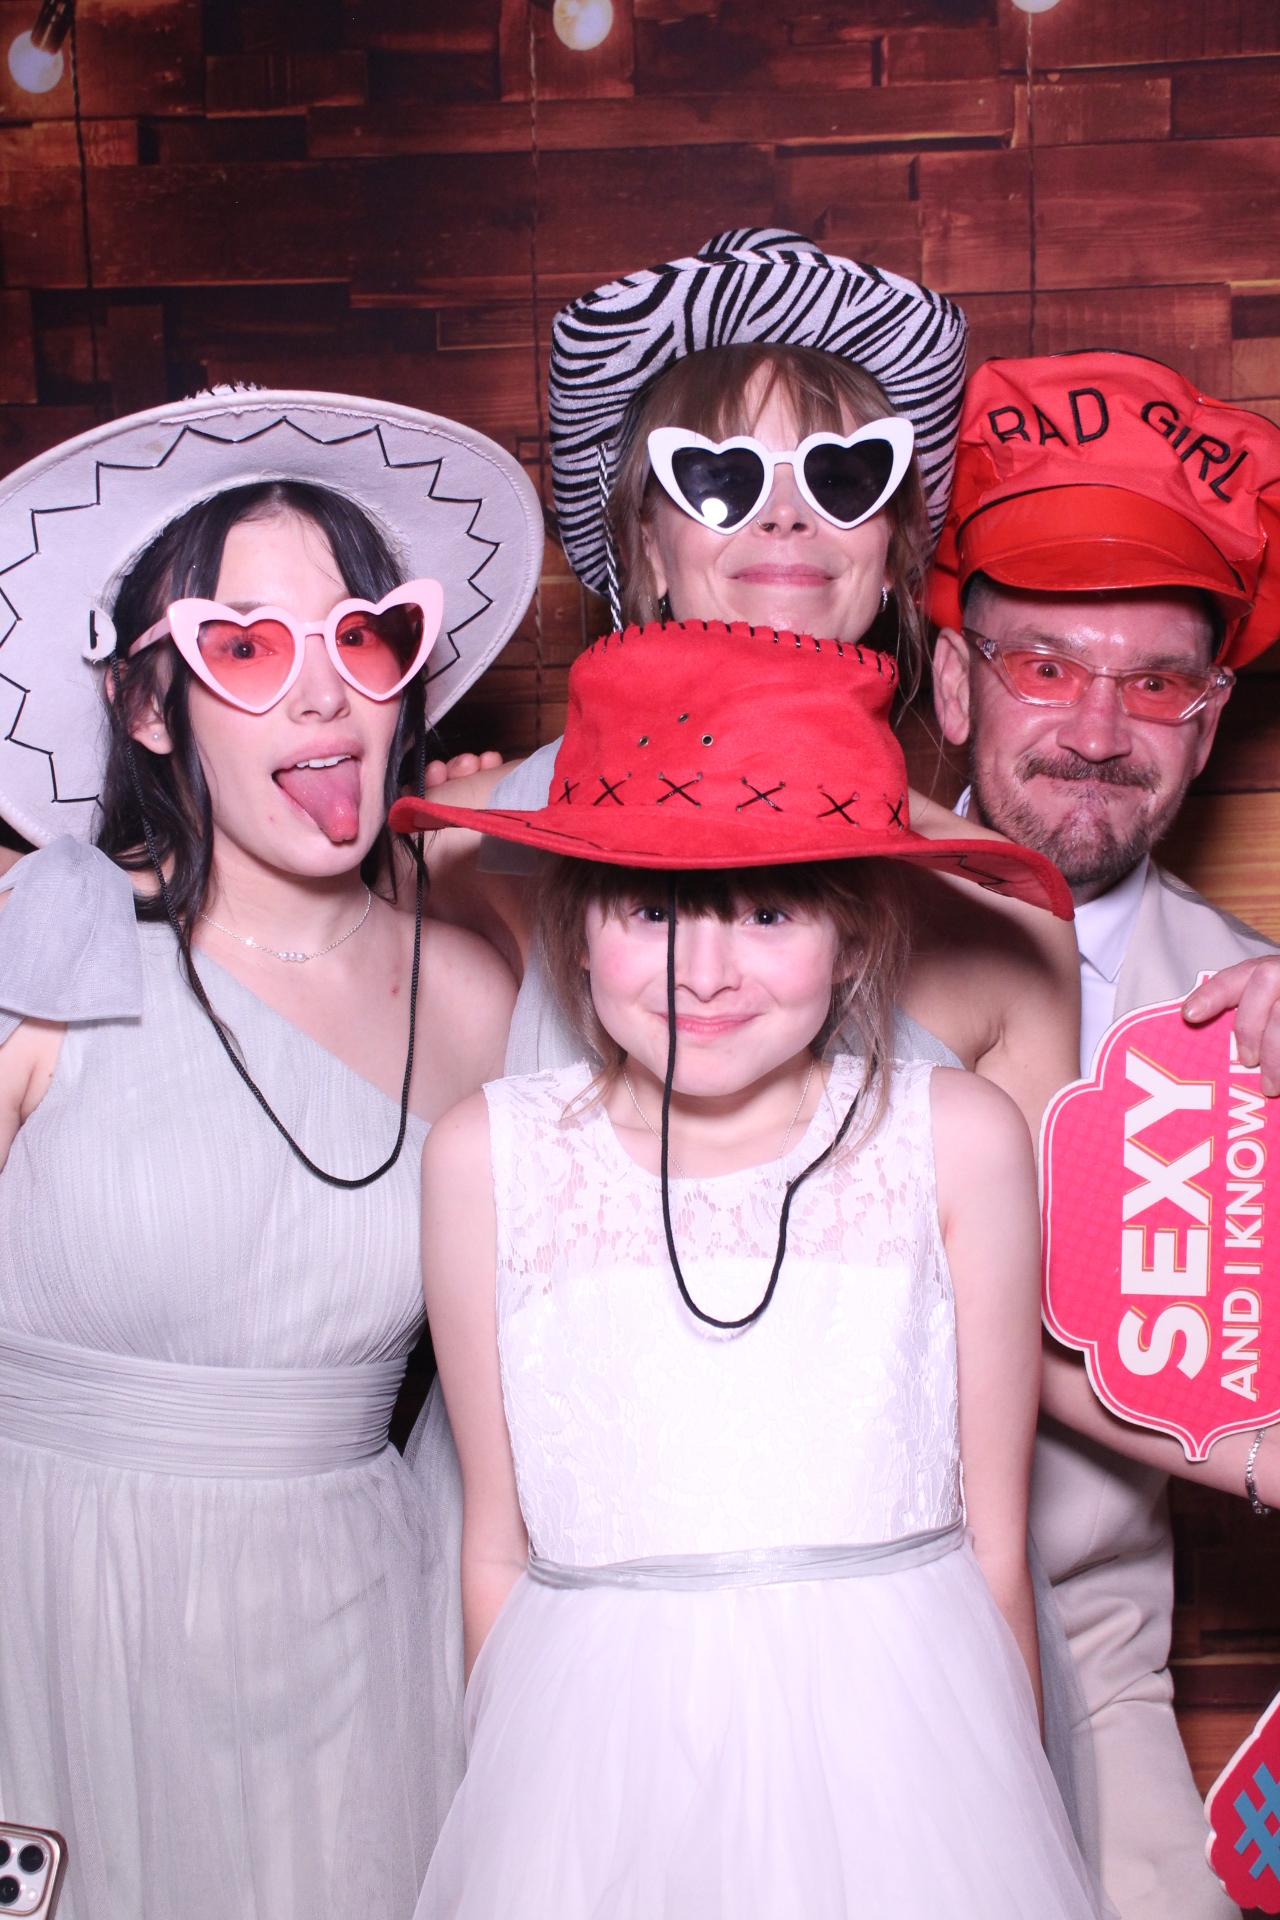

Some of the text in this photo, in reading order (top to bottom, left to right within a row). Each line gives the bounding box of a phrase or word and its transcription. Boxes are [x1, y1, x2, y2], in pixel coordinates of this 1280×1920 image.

[1140, 400, 1249, 503] GIRL
[1117, 1046, 1216, 1381] SEXY
[1224, 1084, 1268, 1249] KNOW
[1224, 1262, 1264, 1276] I
[1220, 1289, 1262, 1402] AND
